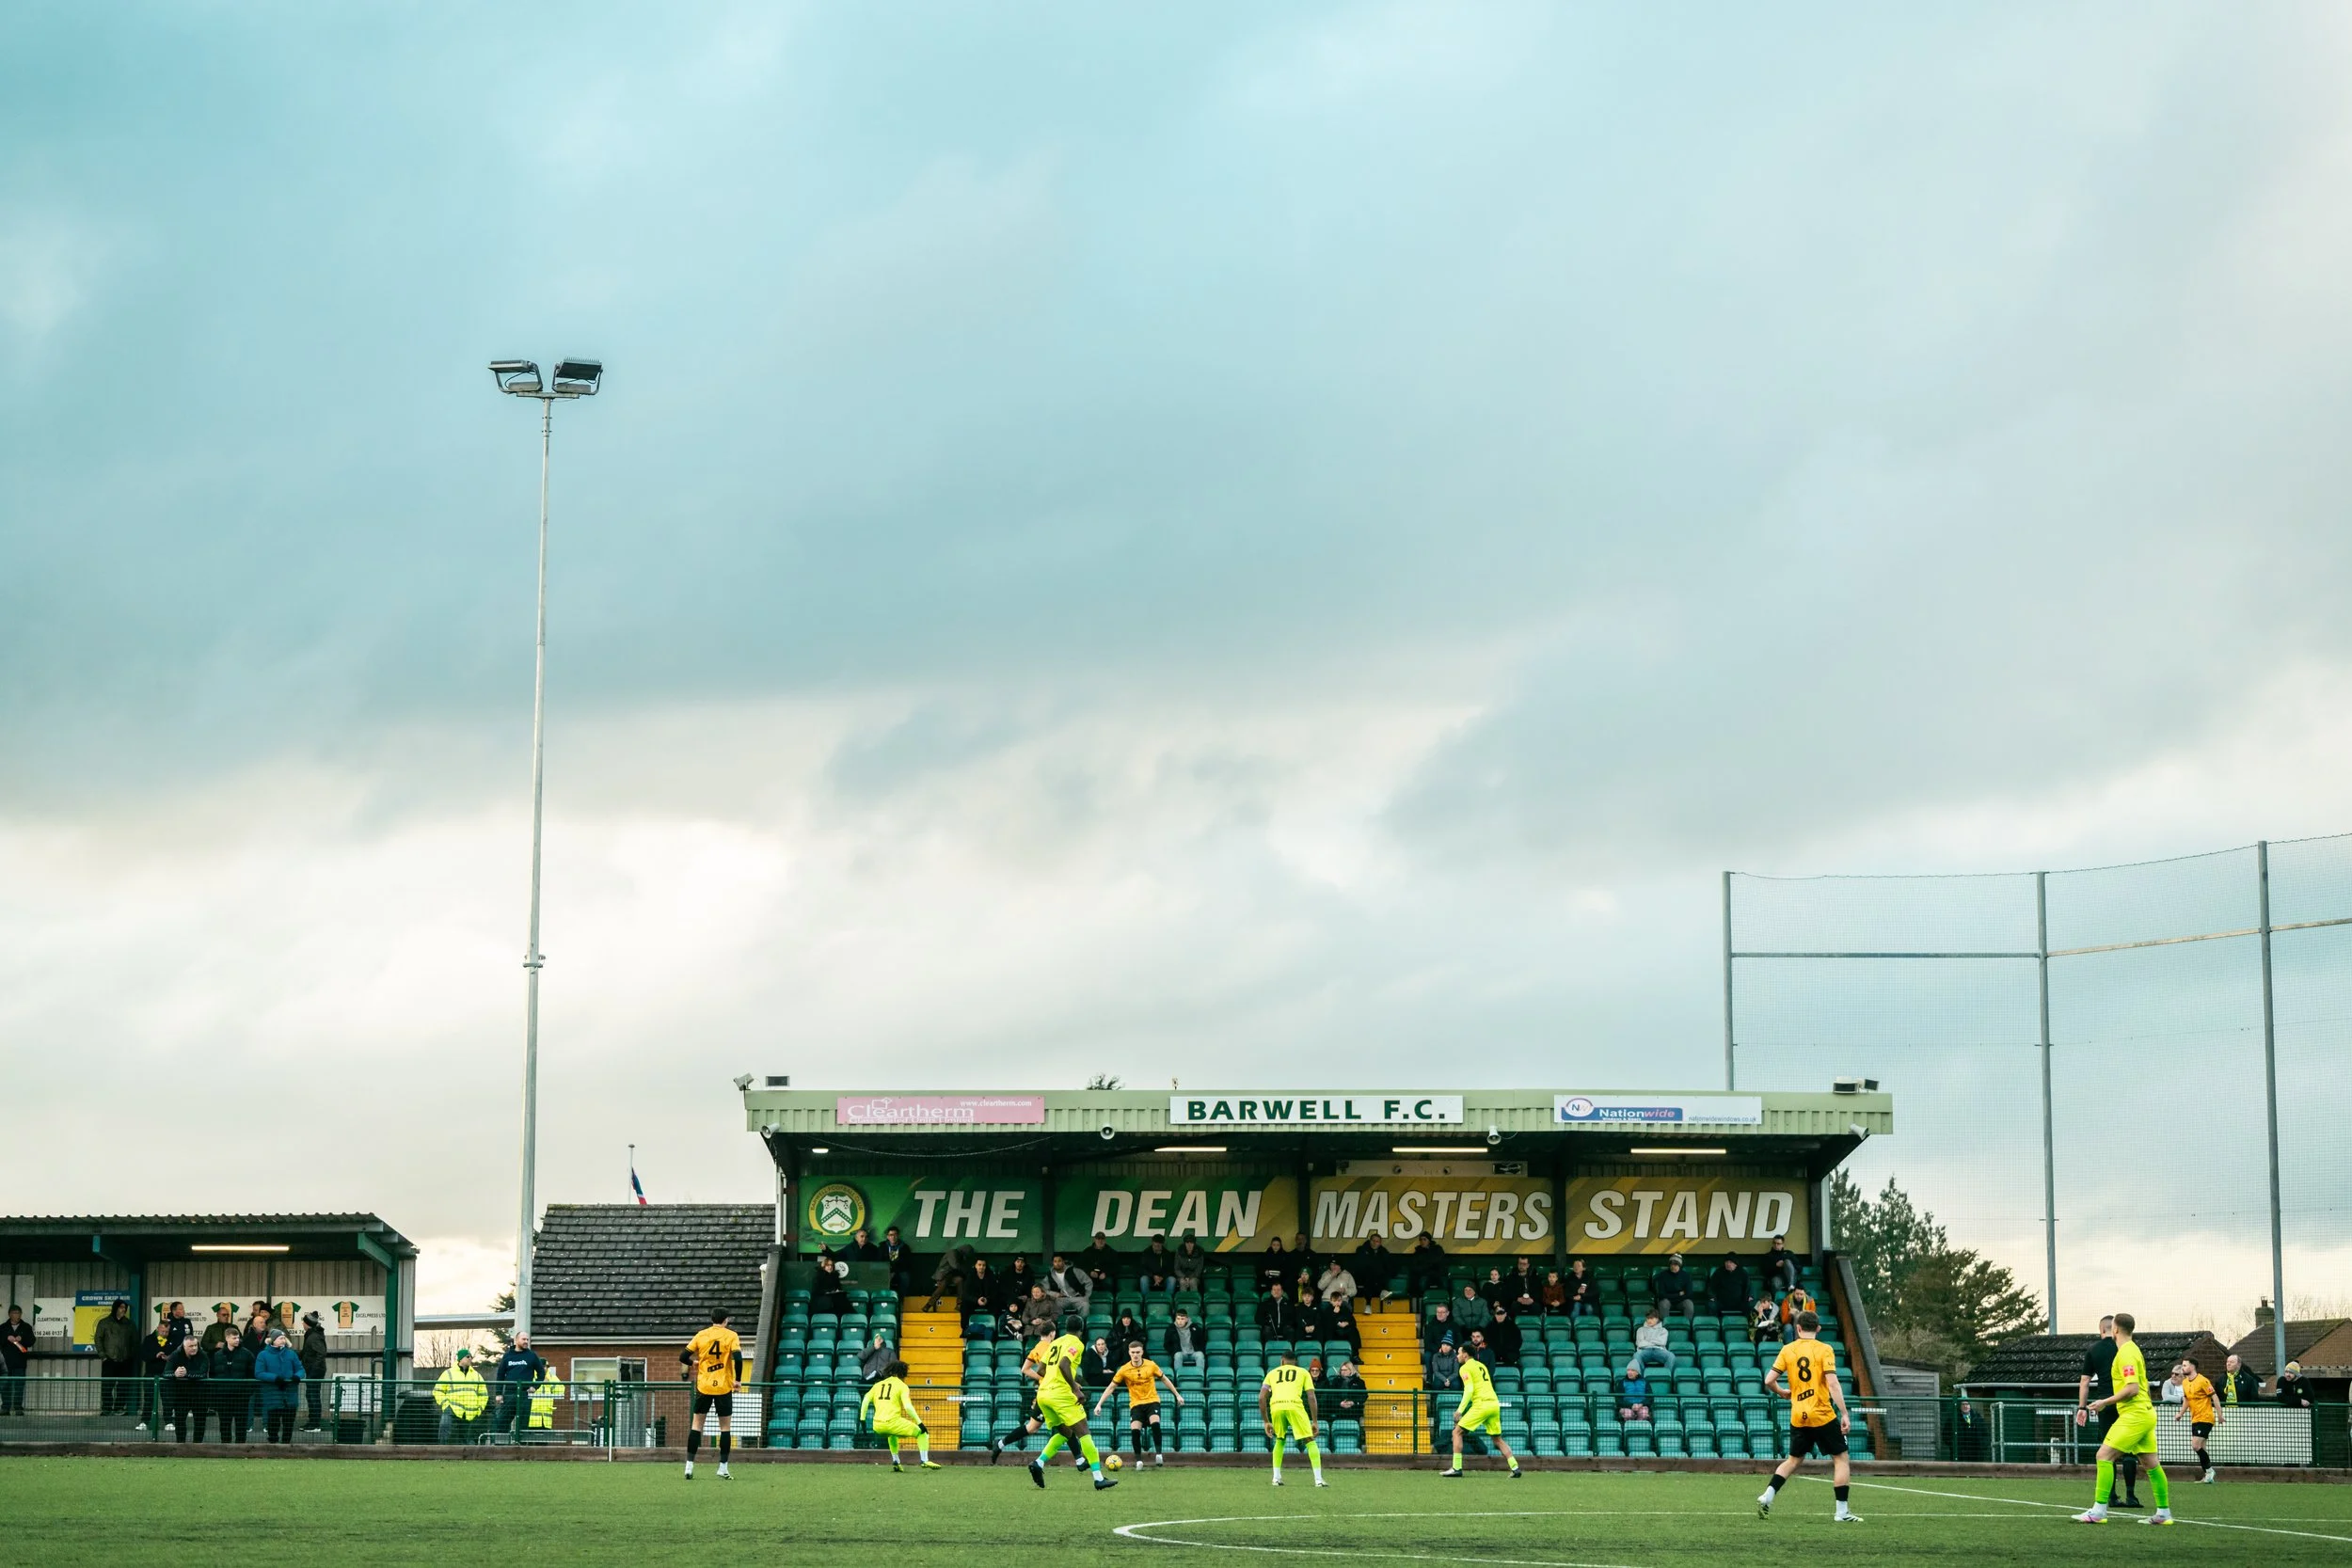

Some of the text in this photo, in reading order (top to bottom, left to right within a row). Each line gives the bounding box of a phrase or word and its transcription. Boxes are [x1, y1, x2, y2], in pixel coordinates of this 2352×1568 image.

[848, 1104, 974, 1118] Cleartherm
[1187, 1100, 1446, 1120] BARWELL F.C.
[1599, 1108, 1676, 1118] Nationwide
[914, 1190, 1794, 1241] THE DEAN MASTERS STAND
[708, 1340, 723, 1360] 4
[1047, 1345, 1062, 1366] 21
[1276, 1369, 1297, 1384] 10
[1479, 1367, 1489, 1382] 2
[1797, 1356, 1812, 1383] 8
[878, 1383, 893, 1401] 11
